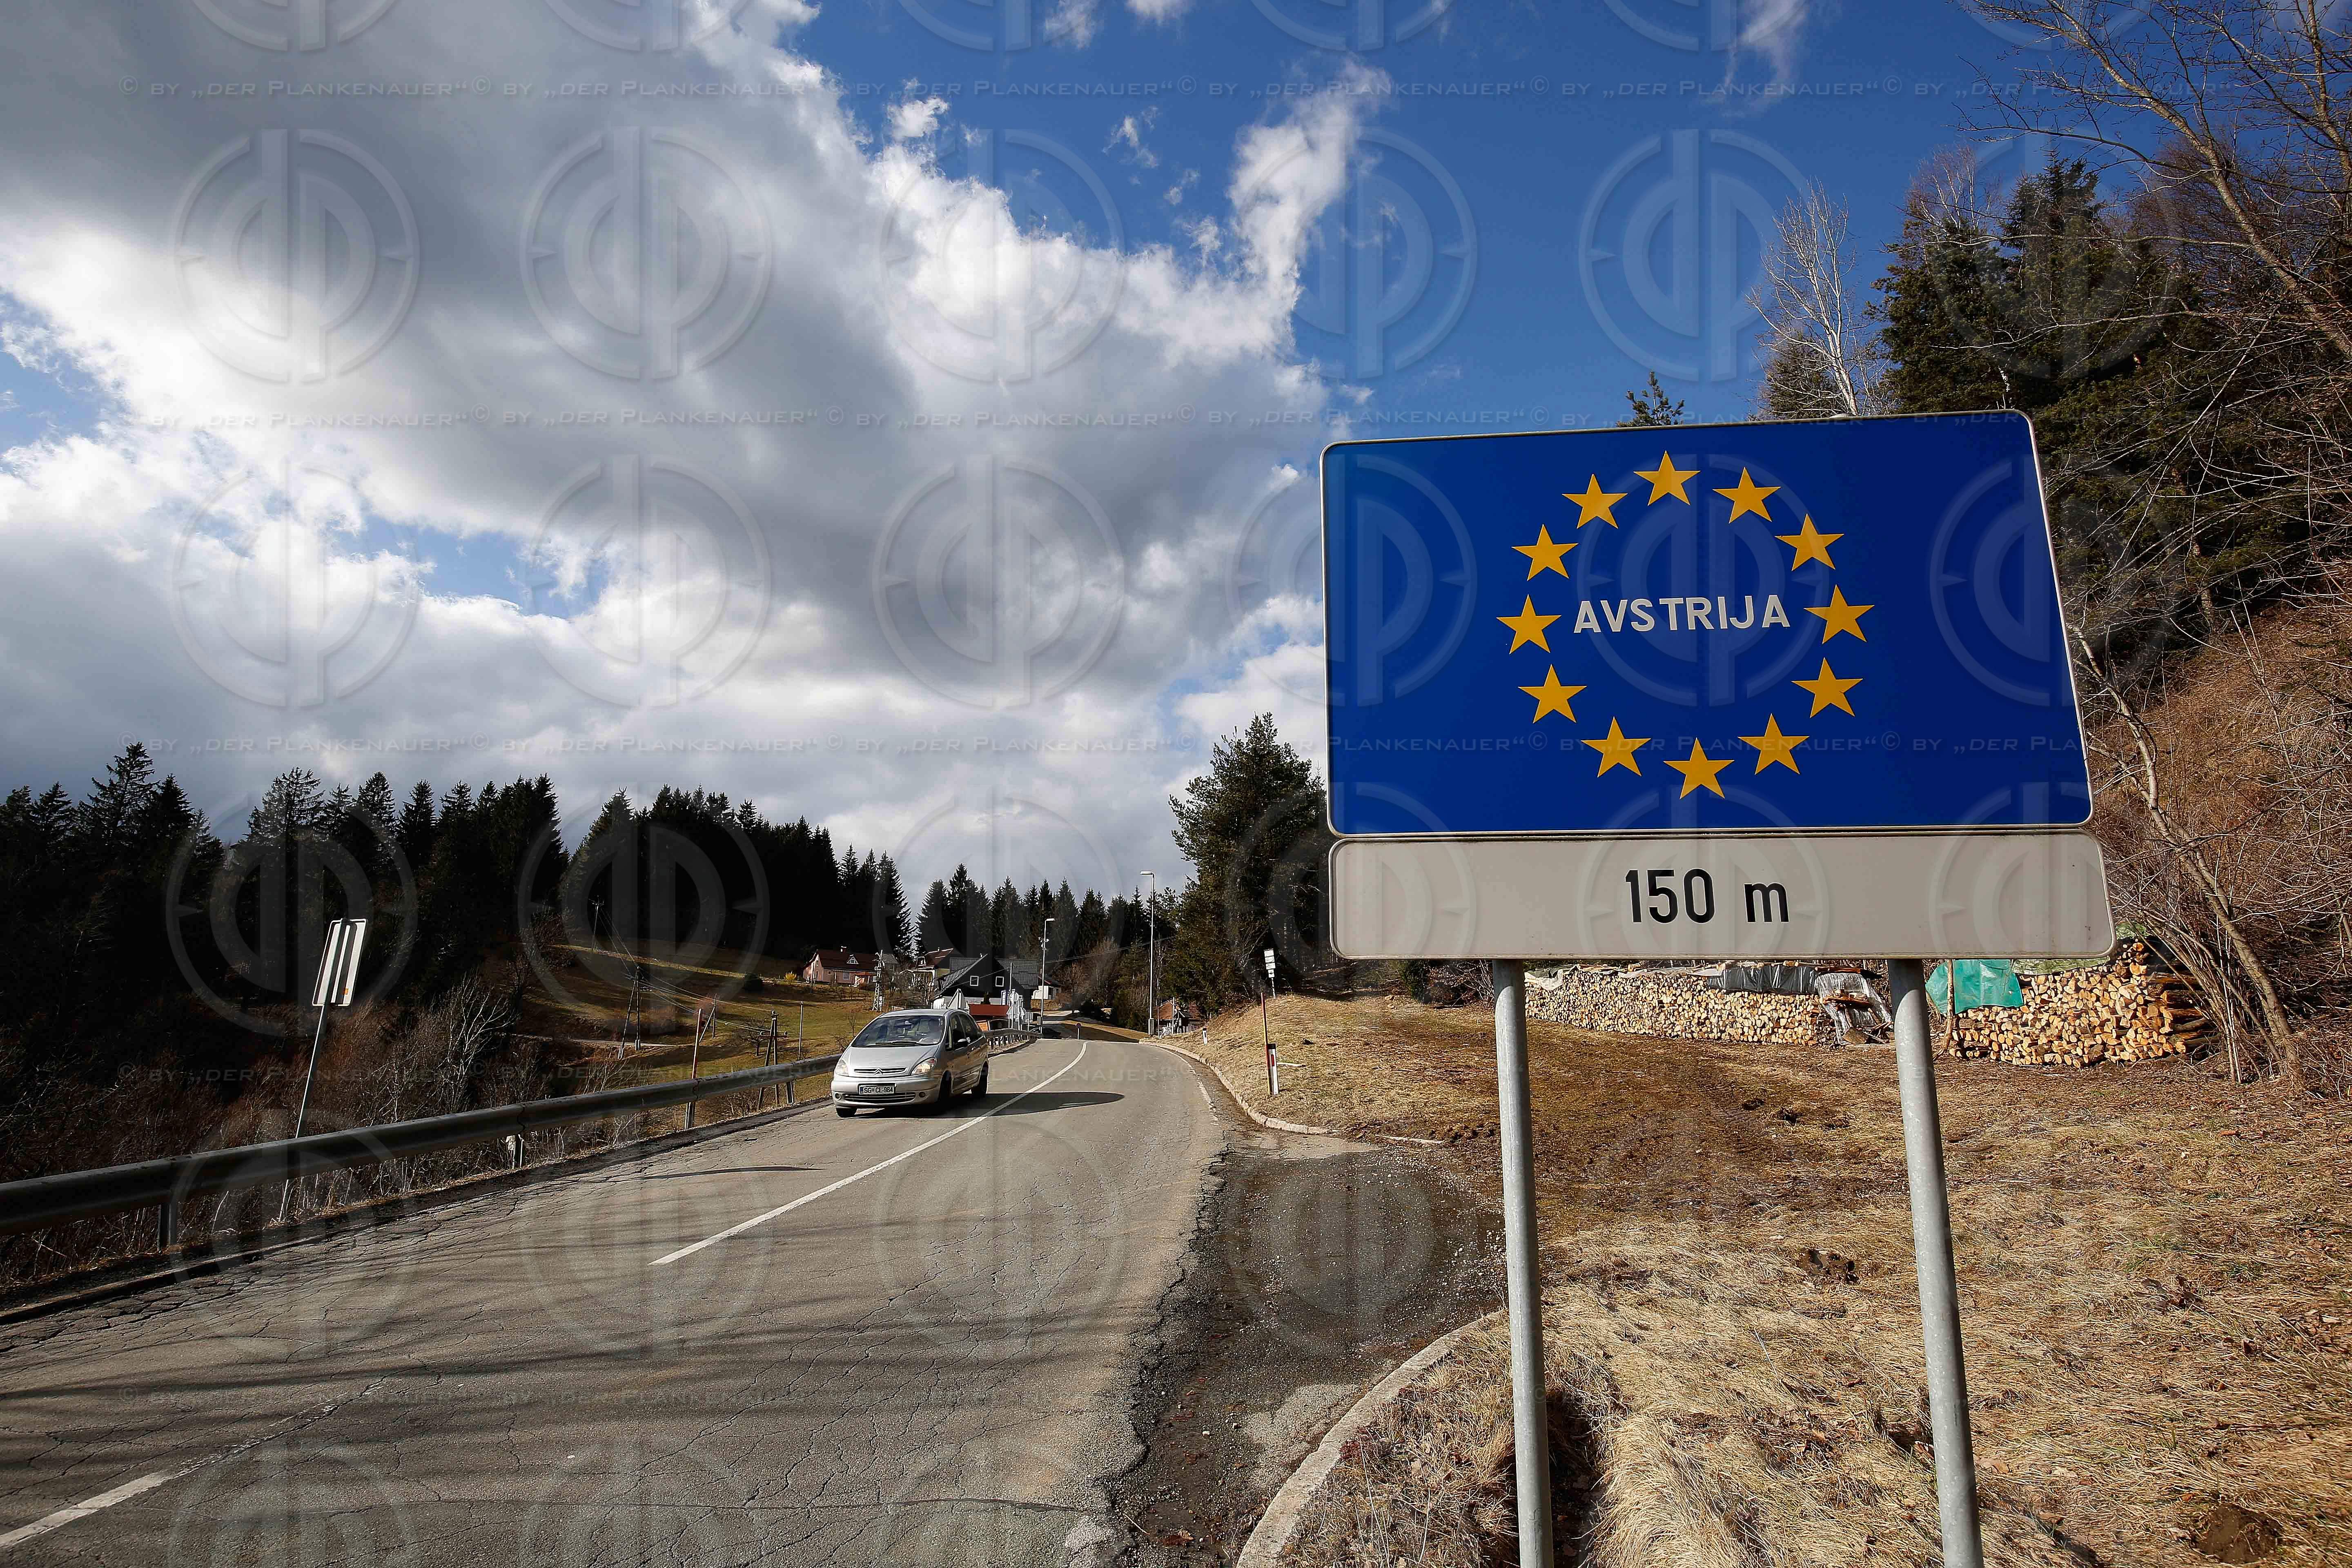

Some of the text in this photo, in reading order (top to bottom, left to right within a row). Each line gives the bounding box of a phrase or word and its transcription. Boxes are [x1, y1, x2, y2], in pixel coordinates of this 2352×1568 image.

[1574, 595, 1791, 633] AVSTRIJA
[1625, 868, 1789, 924] 150 m
